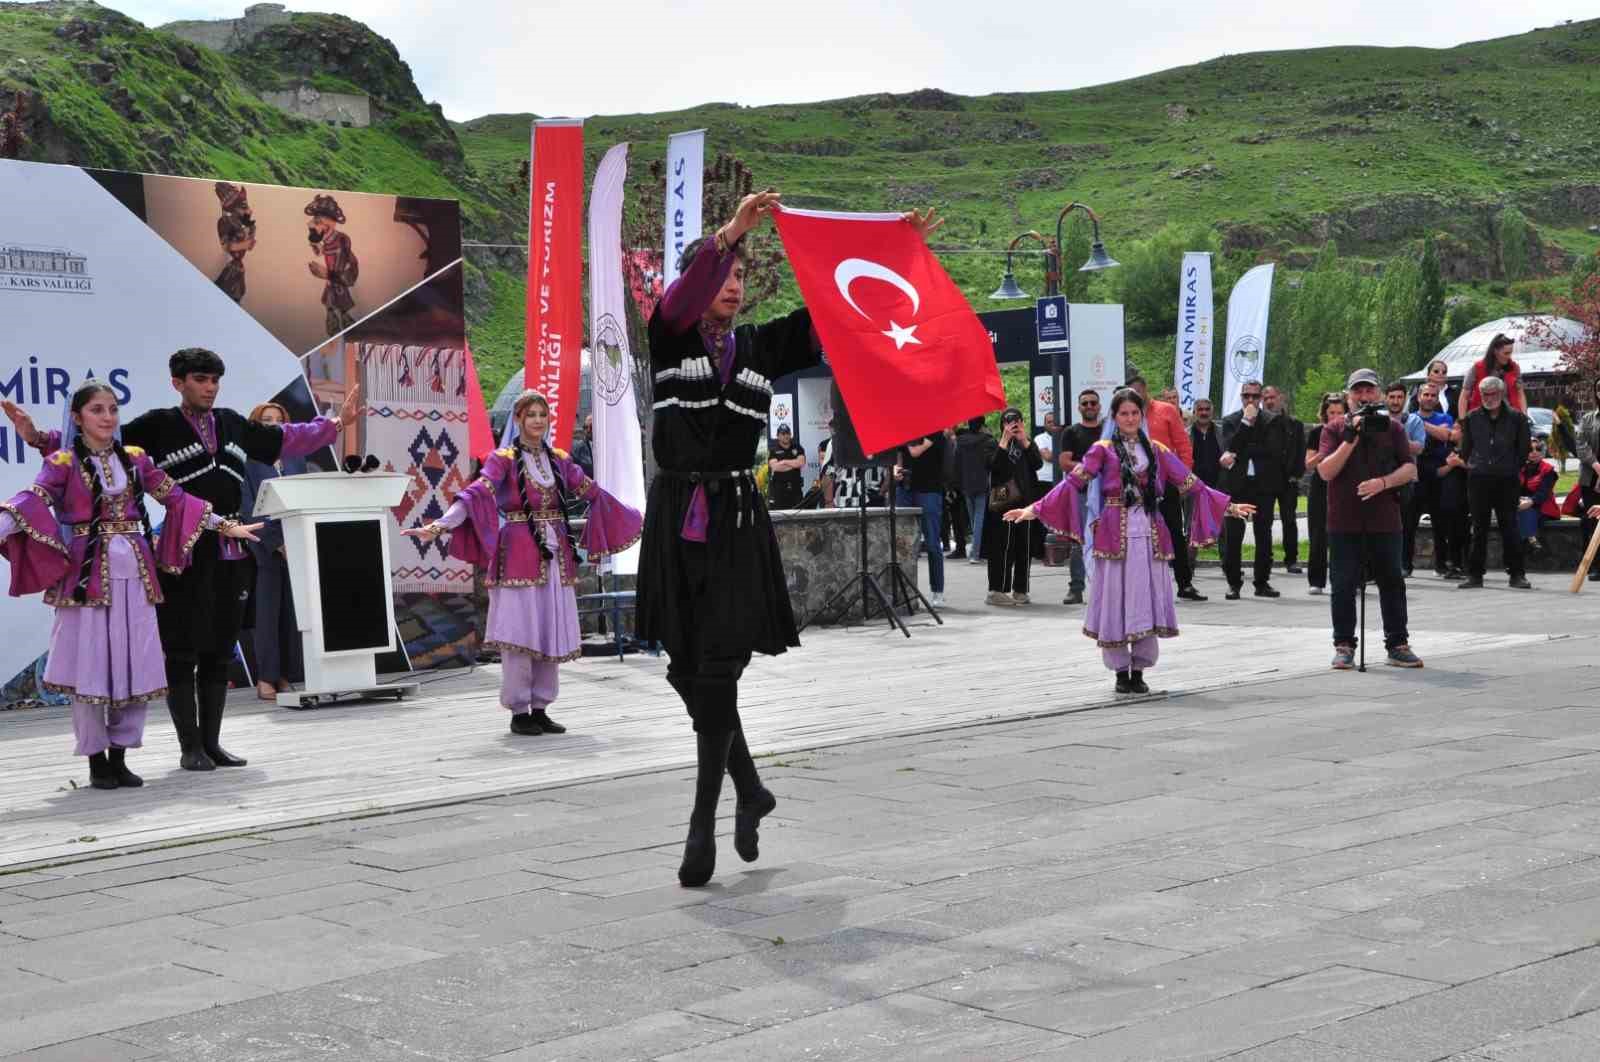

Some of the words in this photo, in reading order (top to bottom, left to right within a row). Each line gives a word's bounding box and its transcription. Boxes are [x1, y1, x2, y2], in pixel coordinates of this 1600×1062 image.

[10, 277, 41, 288] KARS
[540, 284, 550, 314] VE
[0, 355, 132, 406] MİRS
